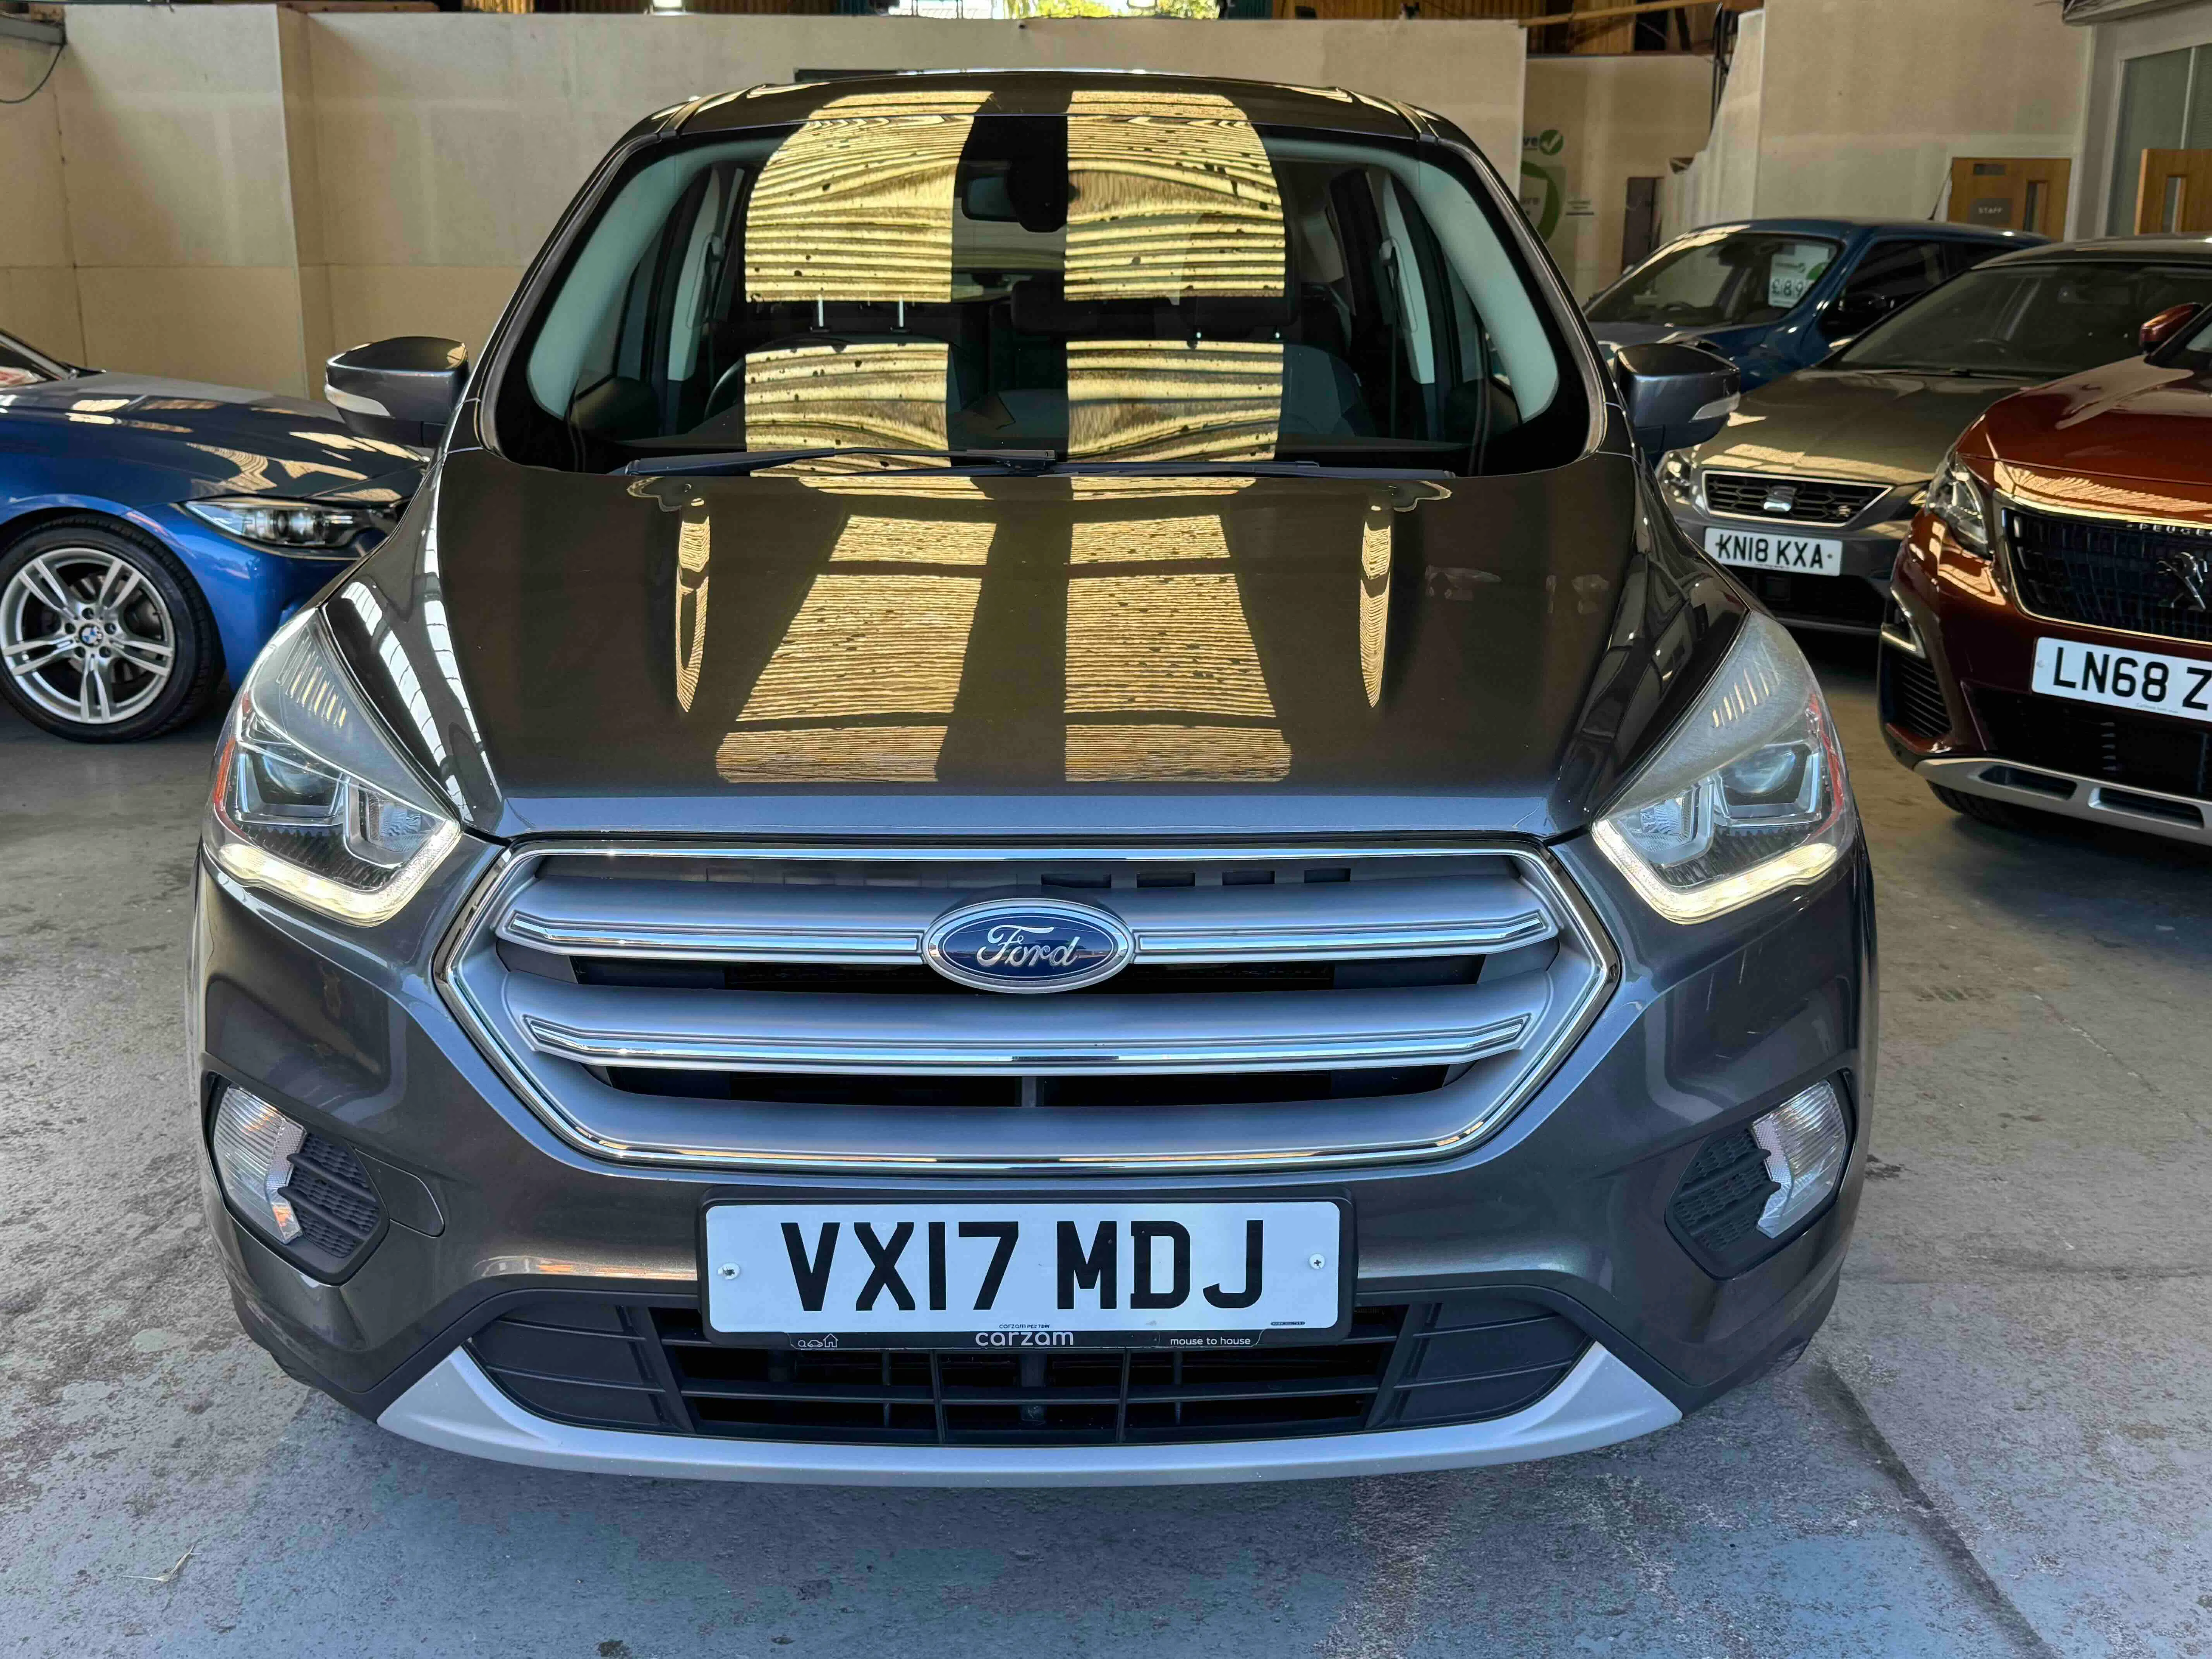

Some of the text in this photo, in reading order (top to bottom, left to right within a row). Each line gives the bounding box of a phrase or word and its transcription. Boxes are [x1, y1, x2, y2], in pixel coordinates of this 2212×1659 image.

[2139, 523, 2212, 537] PEUGE
[1717, 533, 1824, 569] KN18 KXA
[2053, 647, 2212, 711] LN68 Z
[976, 924, 1081, 967] Ford
[780, 1219, 1264, 1312] VX17 MDJ
[975, 1331, 1074, 1346] carzam
[1220, 1336, 1251, 1345] house
